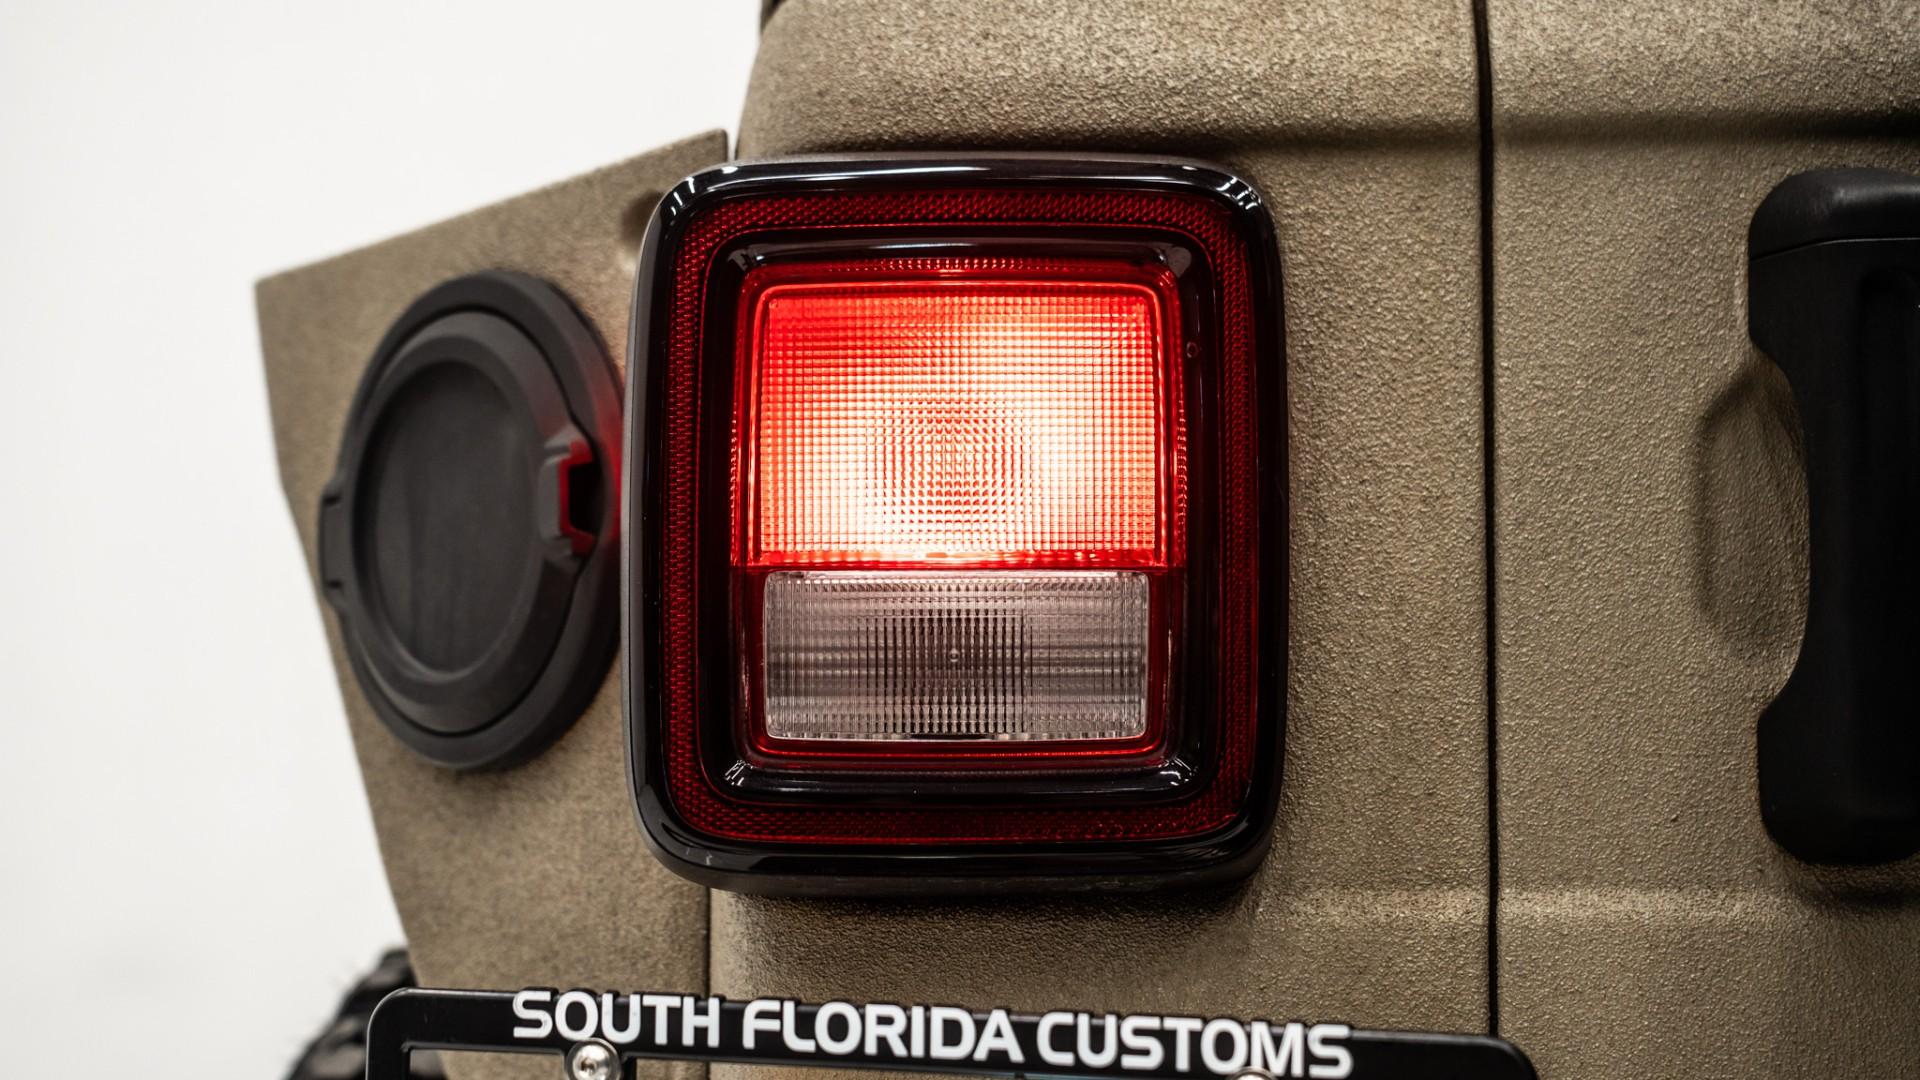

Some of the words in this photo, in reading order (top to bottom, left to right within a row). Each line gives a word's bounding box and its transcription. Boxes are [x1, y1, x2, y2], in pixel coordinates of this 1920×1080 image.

[512, 990, 720, 1047] SOUTH
[742, 999, 1024, 1062] FLORIDA
[1037, 1012, 1352, 1078] CUSTOMS
